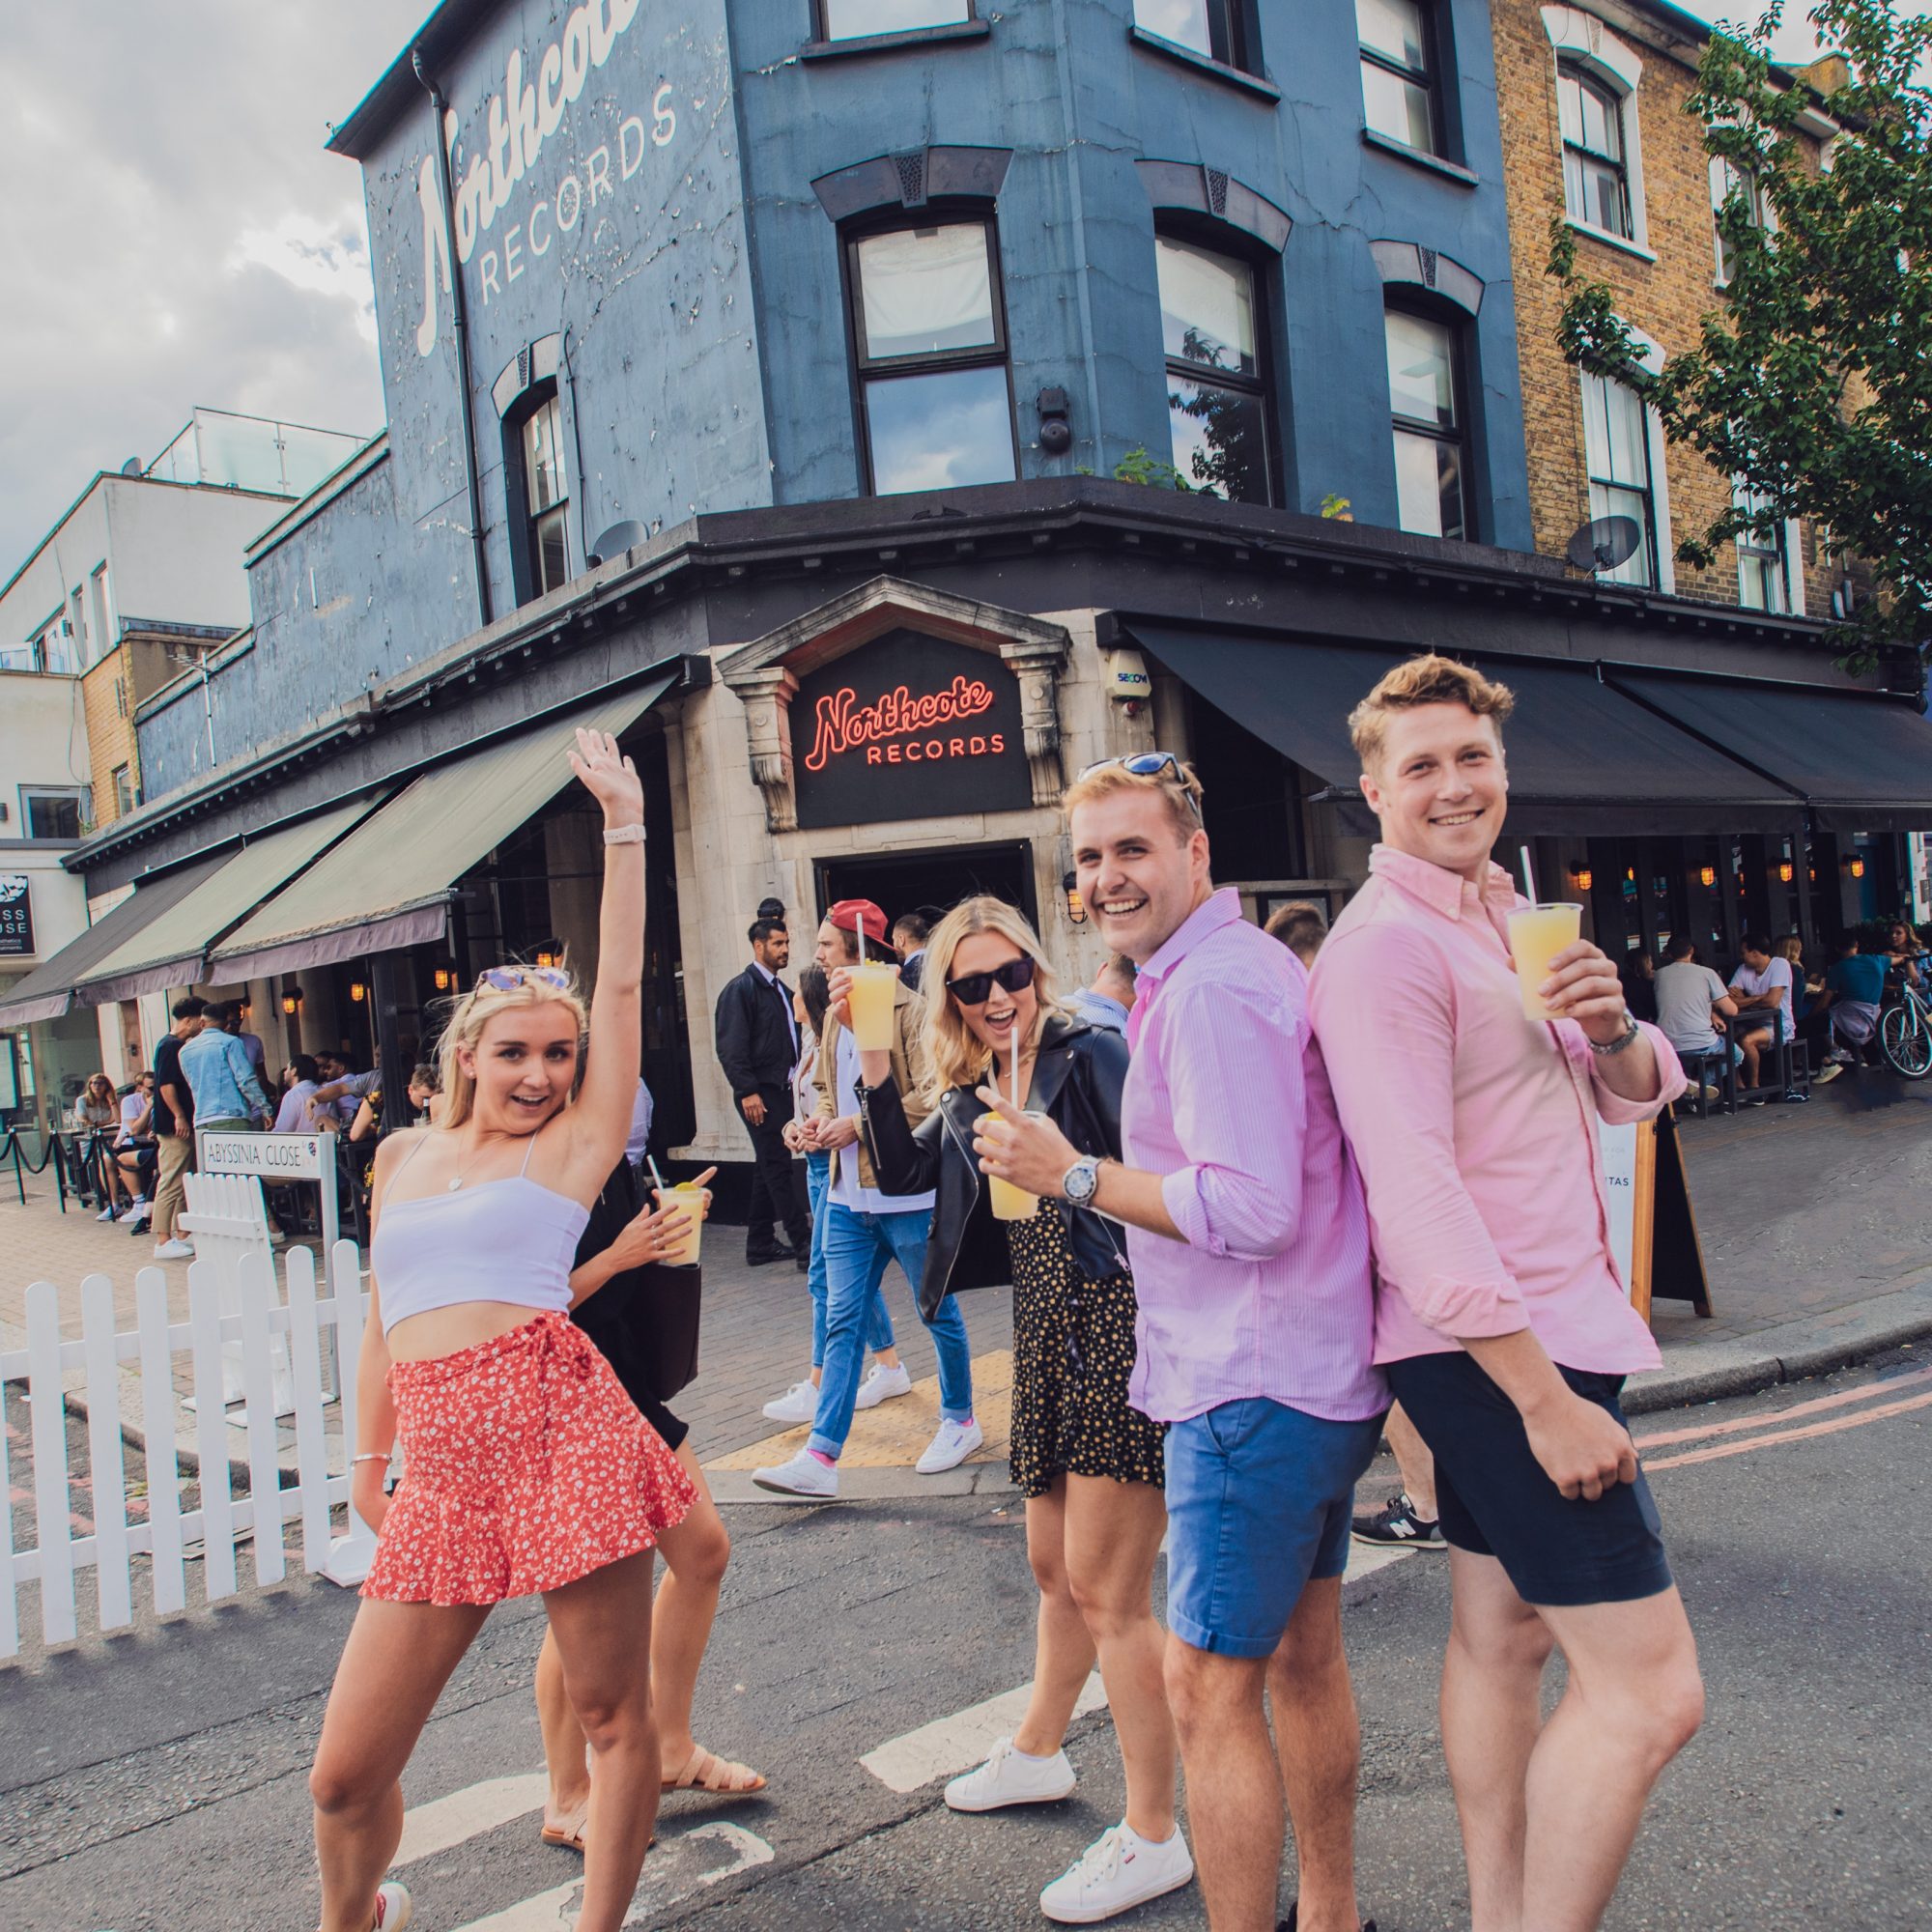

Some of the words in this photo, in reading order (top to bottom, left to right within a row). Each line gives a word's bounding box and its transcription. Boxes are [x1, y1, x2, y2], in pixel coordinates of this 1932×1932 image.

[480, 83, 676, 306] RECORDS
[1117, 672, 1148, 684] SECOM
[805, 675, 993, 771] Northcote
[867, 733, 1005, 765] RECORDS
[208, 1143, 262, 1165] ABYSSINIA
[265, 1145, 301, 1167] CLOSE
